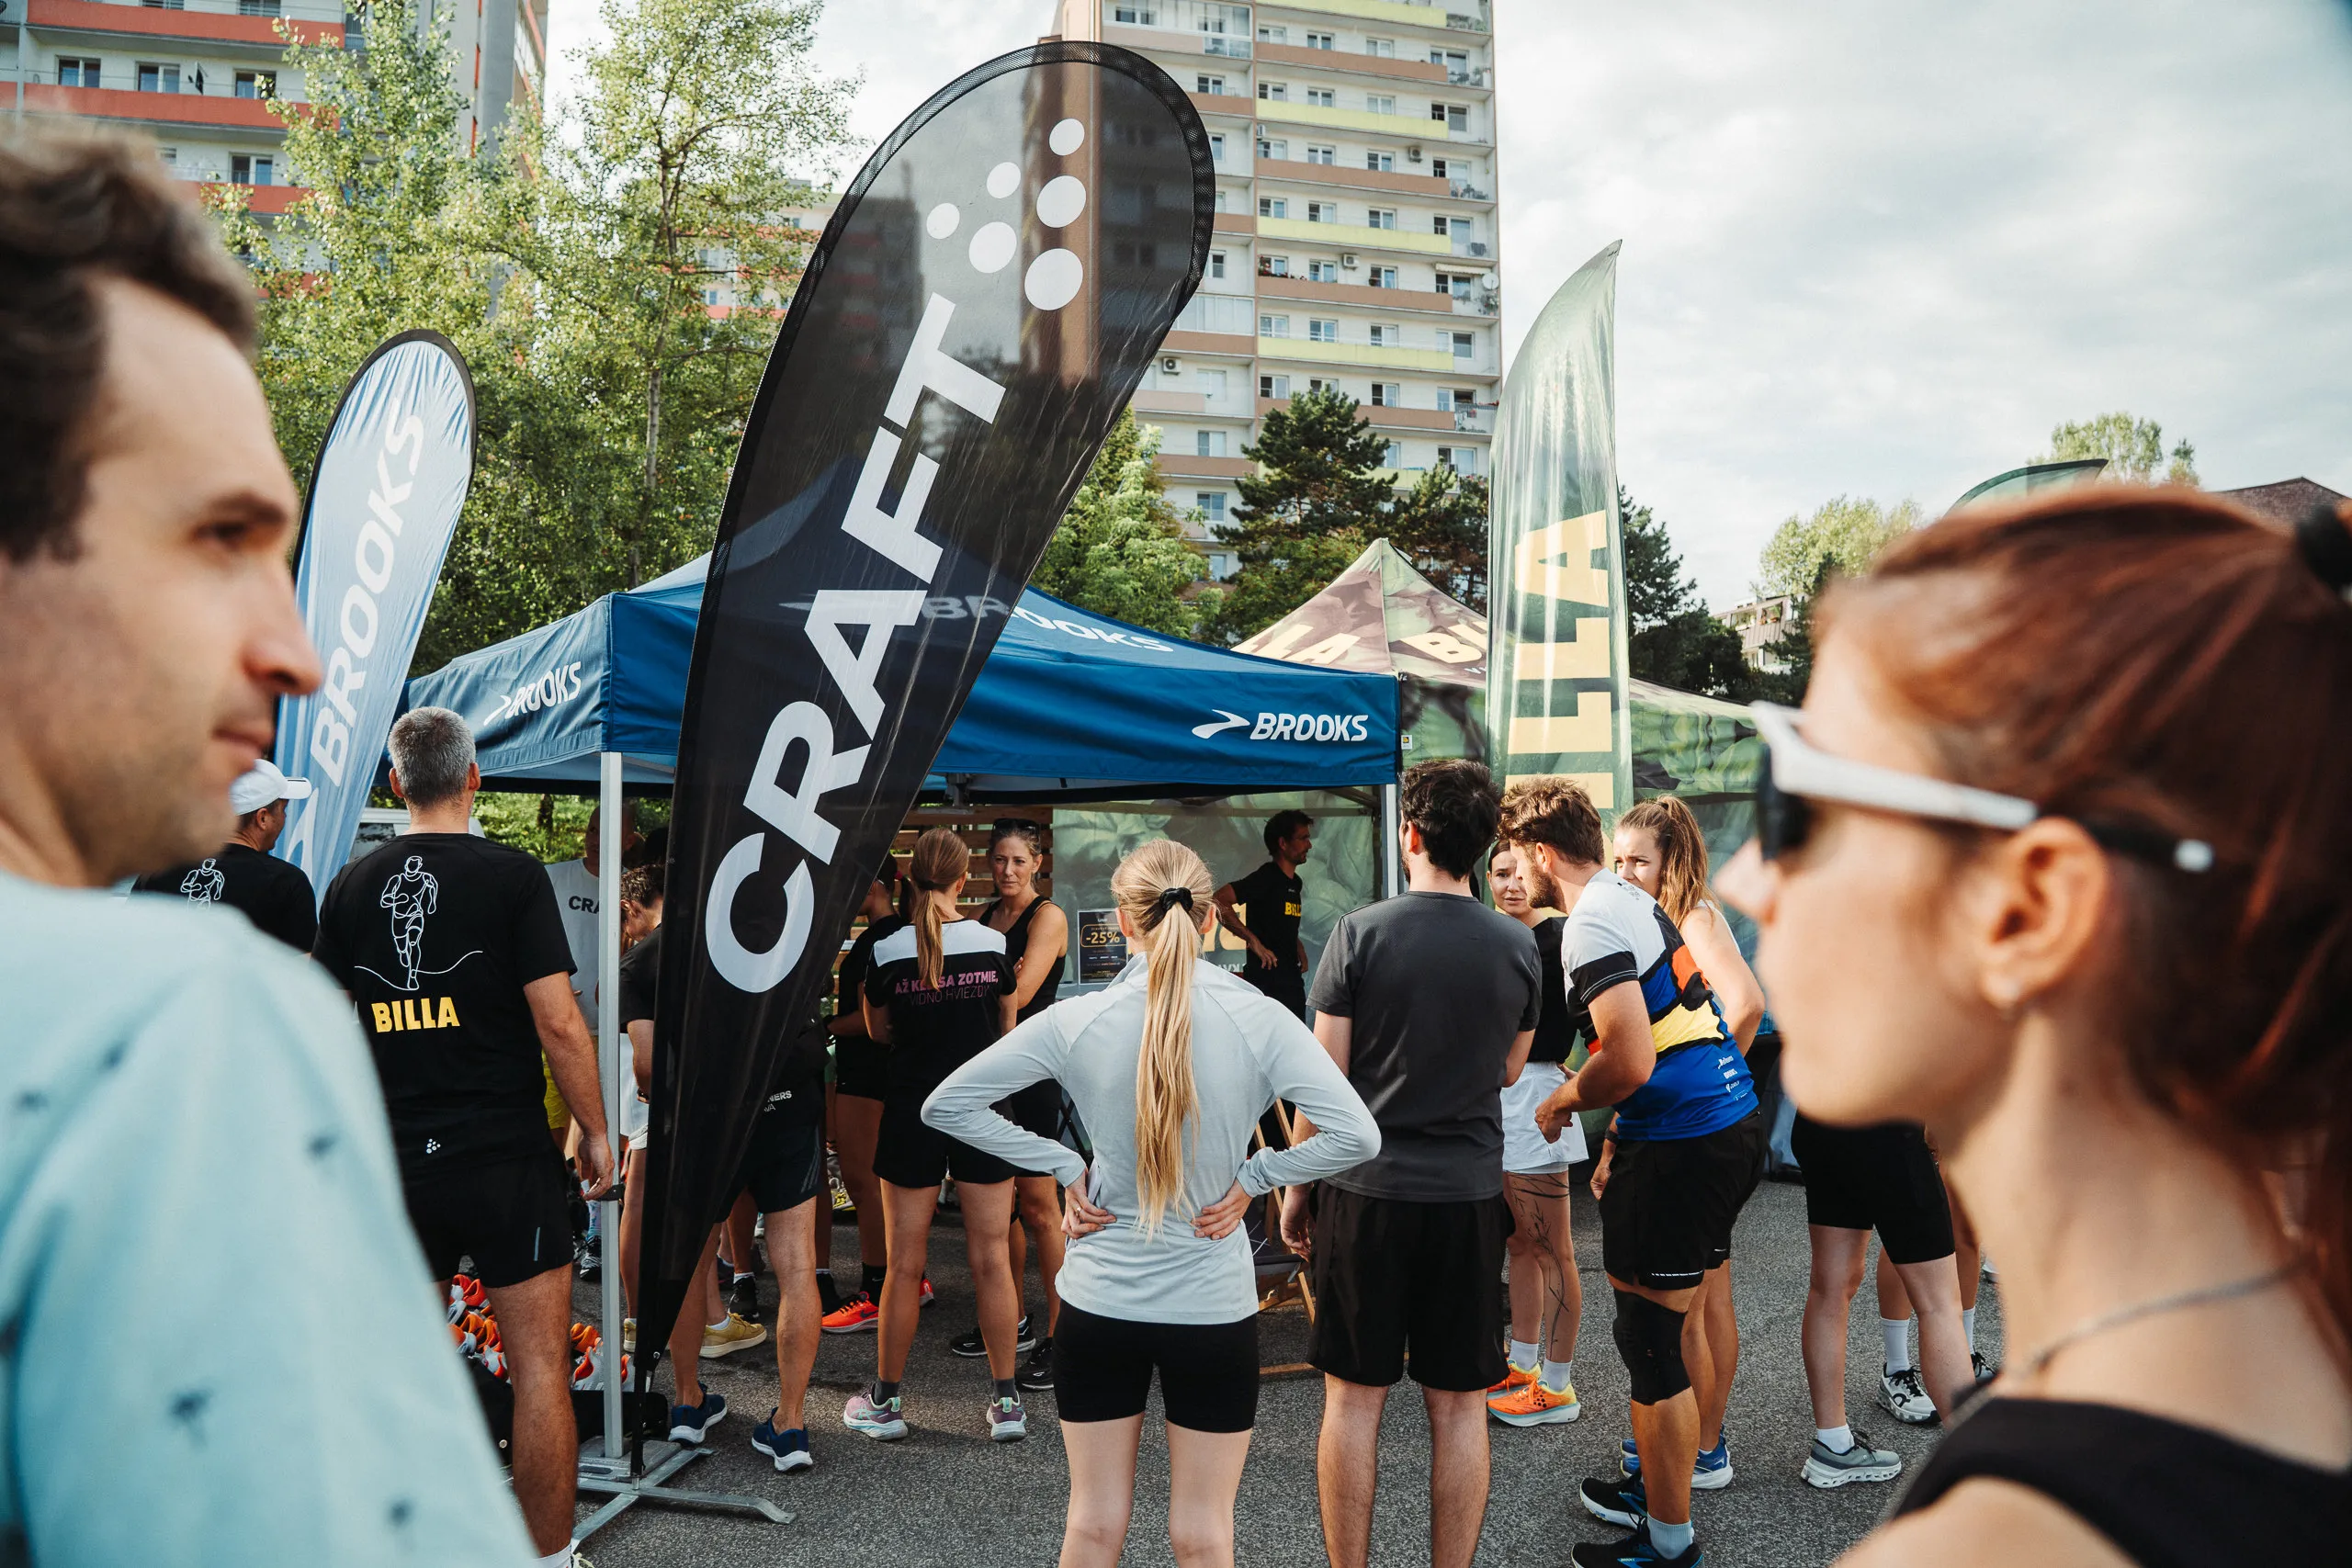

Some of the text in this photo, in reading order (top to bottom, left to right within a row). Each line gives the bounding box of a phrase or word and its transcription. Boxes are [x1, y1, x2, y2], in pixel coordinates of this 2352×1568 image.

[311, 398, 424, 787] BROOKS
[705, 293, 1006, 994] CRAFT
[1505, 510, 1614, 809] ILLA
[505, 661, 581, 719] BROOKS
[1250, 712, 1369, 742] BROOKS
[1284, 901, 1301, 917] BILL
[1086, 931, 1120, 944] -25%
[958, 971, 999, 986] ZOTMIE,
[371, 997, 460, 1032] BILLA
[768, 1090, 792, 1102] NERS
